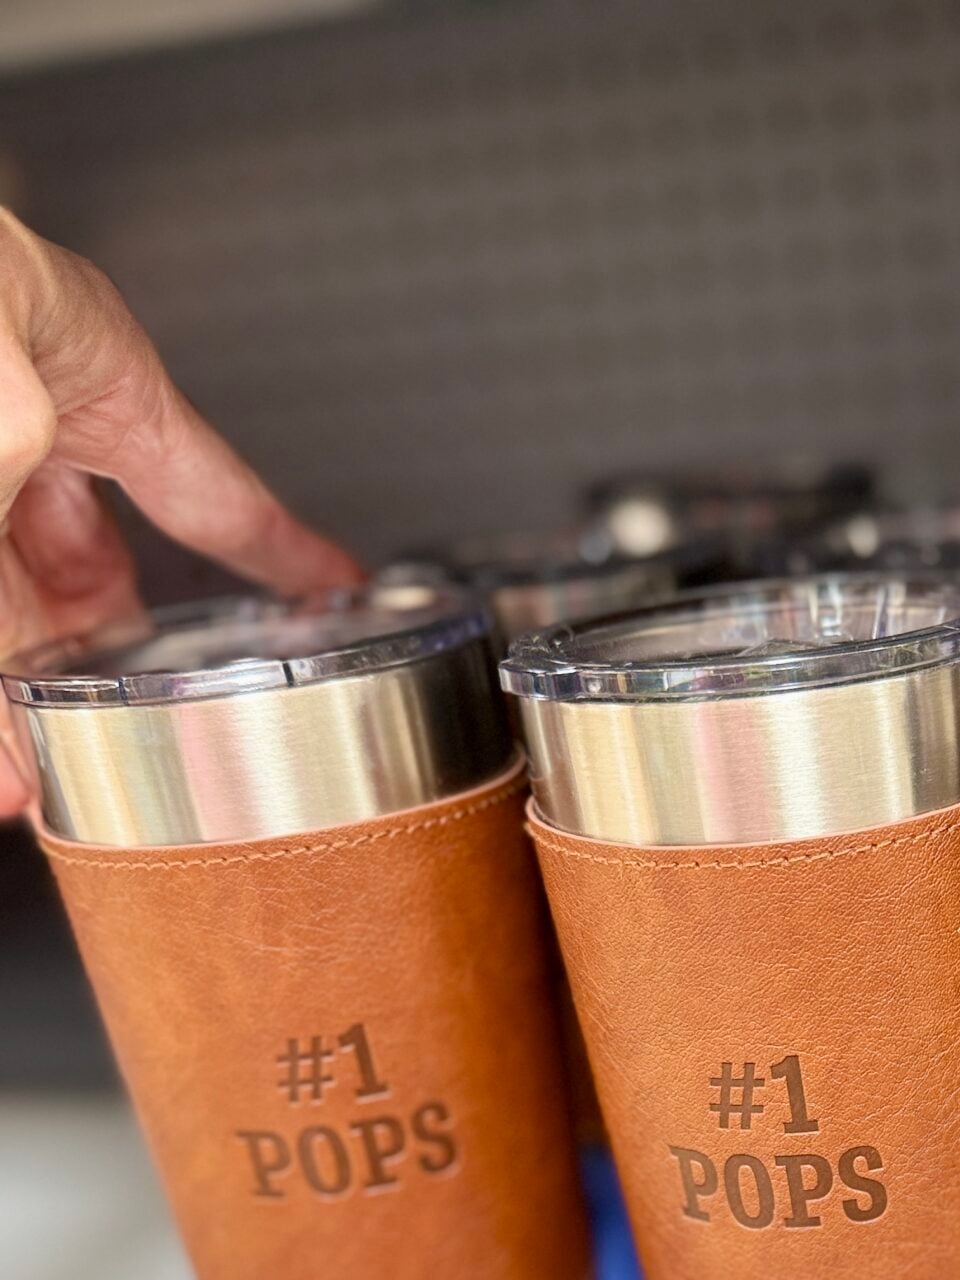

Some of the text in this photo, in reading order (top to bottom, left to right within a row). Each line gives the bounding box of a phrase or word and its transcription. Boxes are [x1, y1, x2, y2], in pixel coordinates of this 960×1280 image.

[275, 1022, 389, 1103] #1
[708, 1053, 820, 1134] #1
[235, 1101, 460, 1199] POPS
[668, 1144, 889, 1228] POPS
